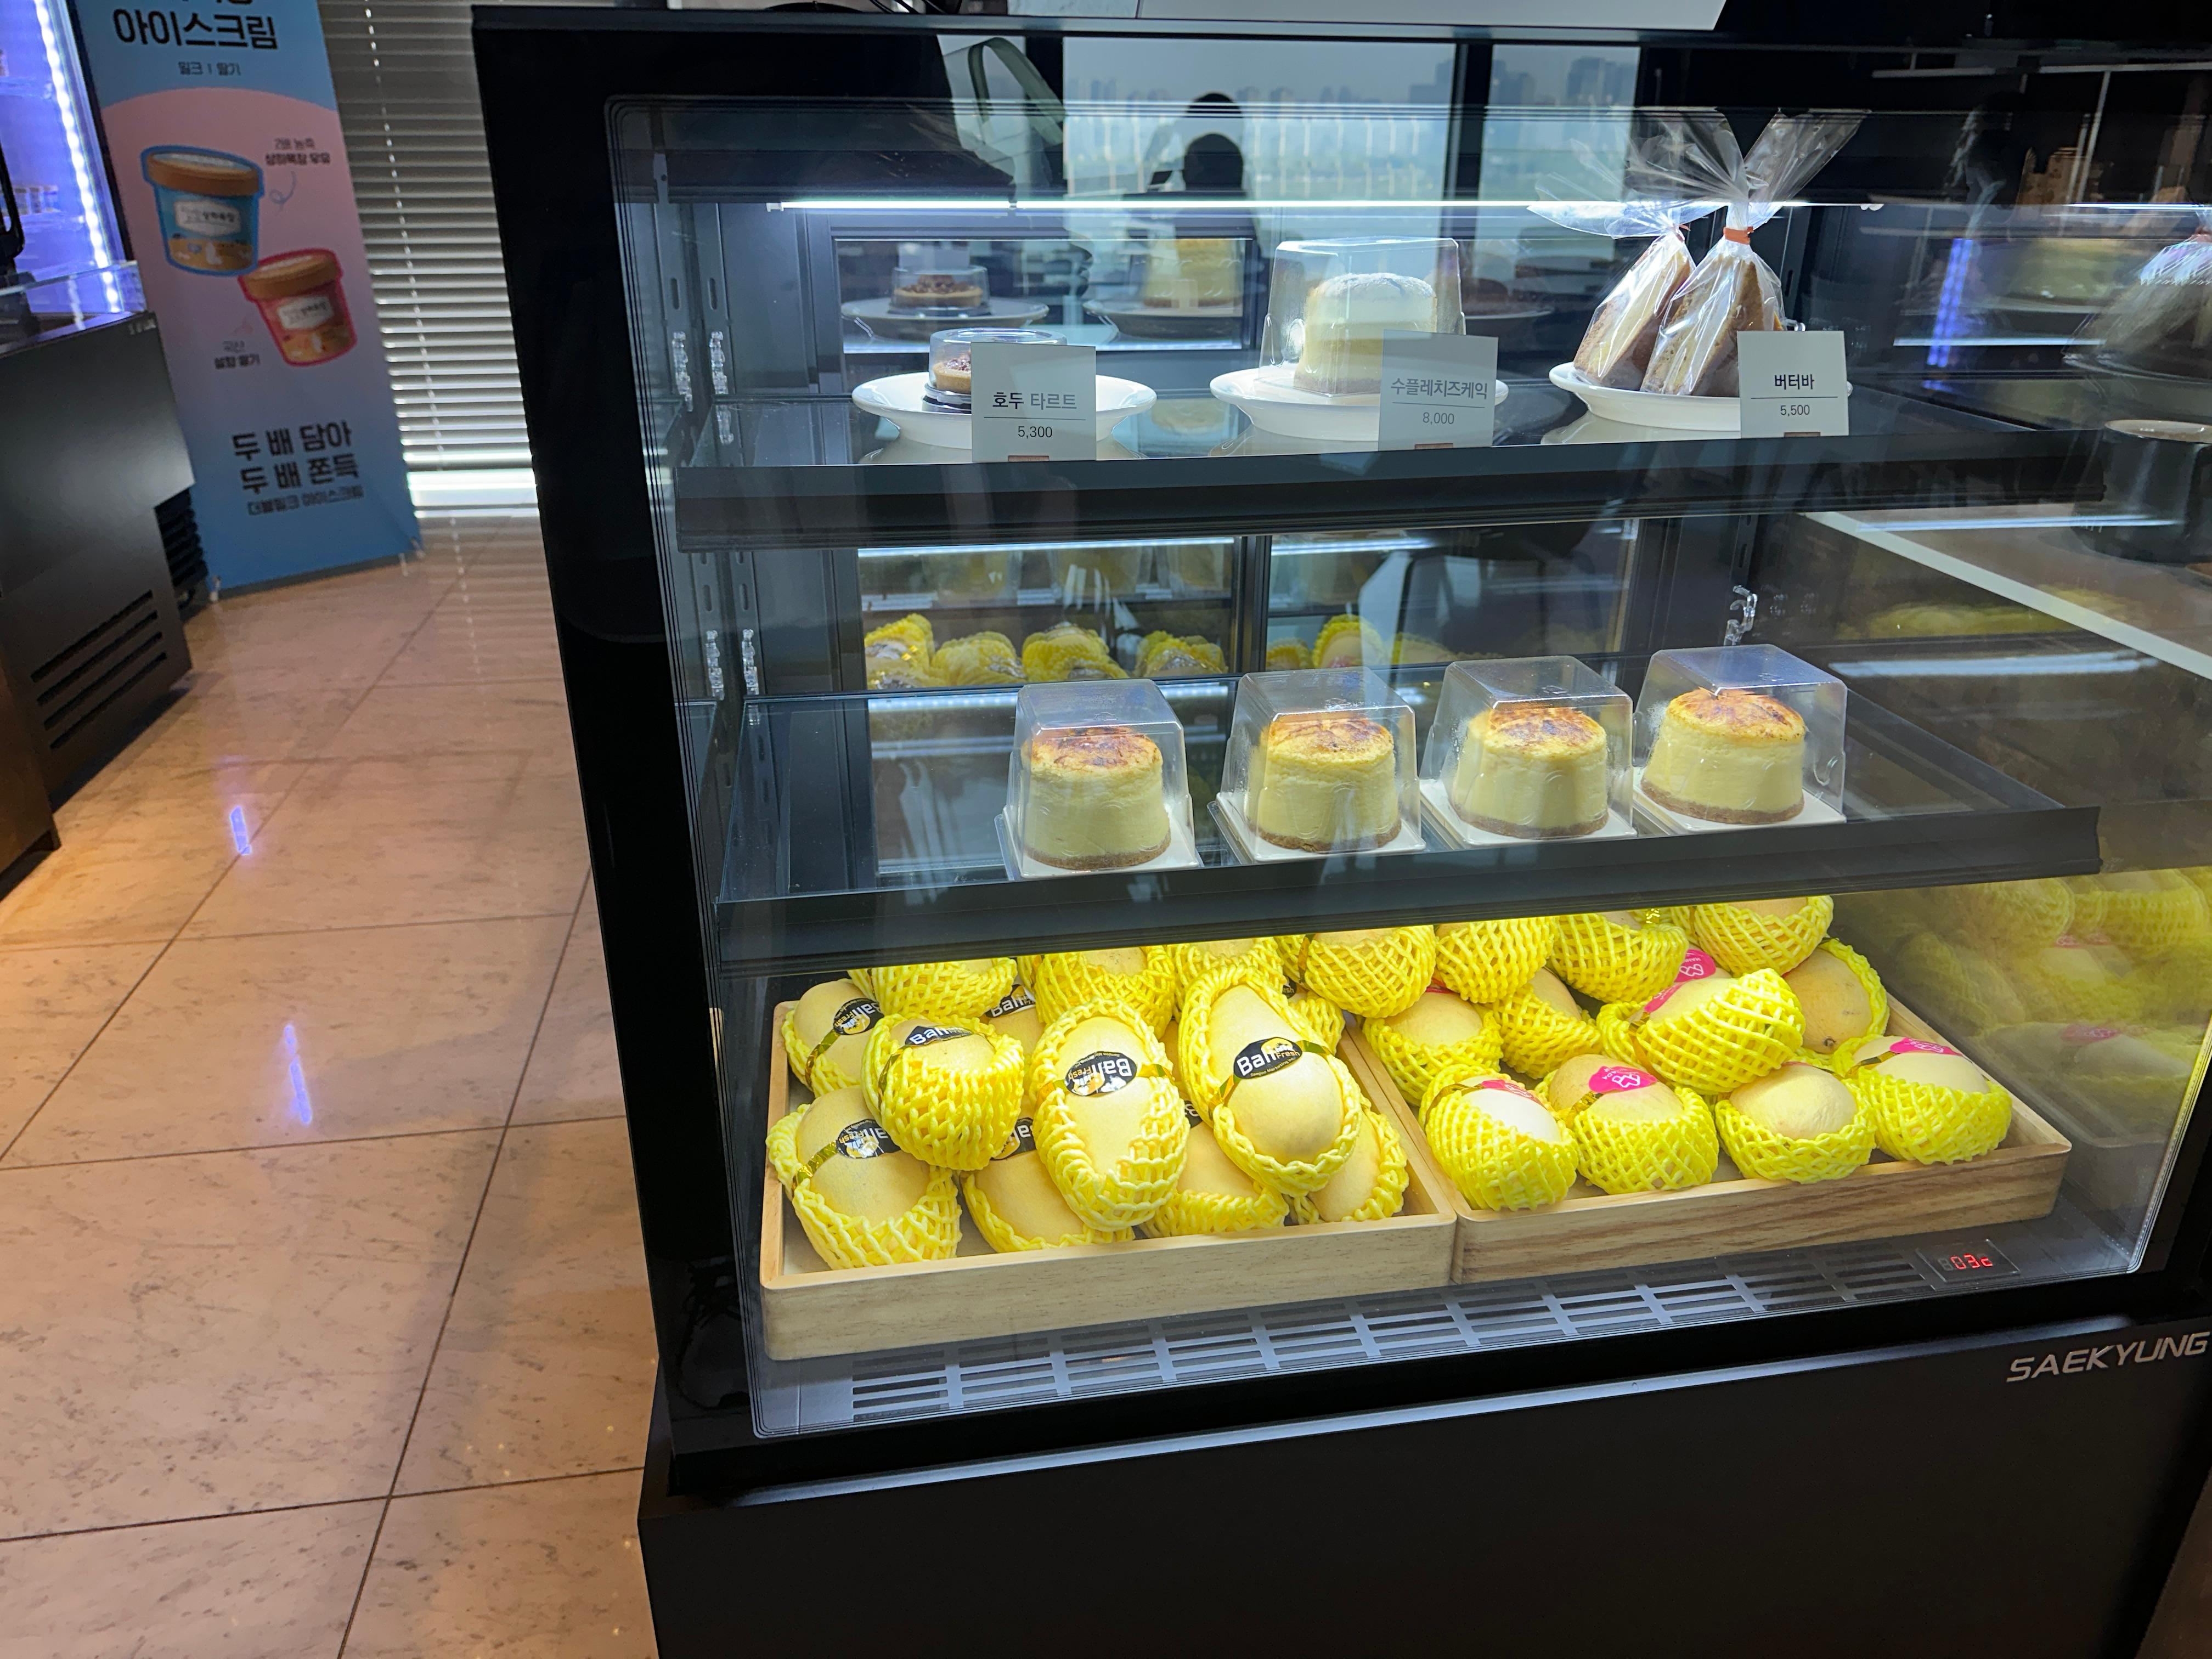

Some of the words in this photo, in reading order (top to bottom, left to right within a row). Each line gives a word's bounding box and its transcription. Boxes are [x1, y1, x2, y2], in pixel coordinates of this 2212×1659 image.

[113, 9, 278, 49] 아이스크림
[1391, 377, 1487, 399] 수플레치즈케익
[1775, 374, 1815, 390] 버터바
[992, 392, 1024, 409] 호두
[1030, 393, 1077, 410] 타르트
[1780, 404, 1810, 416] 5,500
[1423, 412, 1454, 425] 8,000
[233, 432, 261, 461] 두
[265, 427, 294, 456] 배
[299, 419, 352, 452] 담아
[1018, 426, 1052, 439] 5,300
[240, 467, 269, 494] 두
[274, 461, 302, 489] 배
[307, 453, 359, 484] 쫀득
[1276, 1051, 1300, 1059] Fresh
[2006, 1331, 2210, 1383] SAEKYUNG
